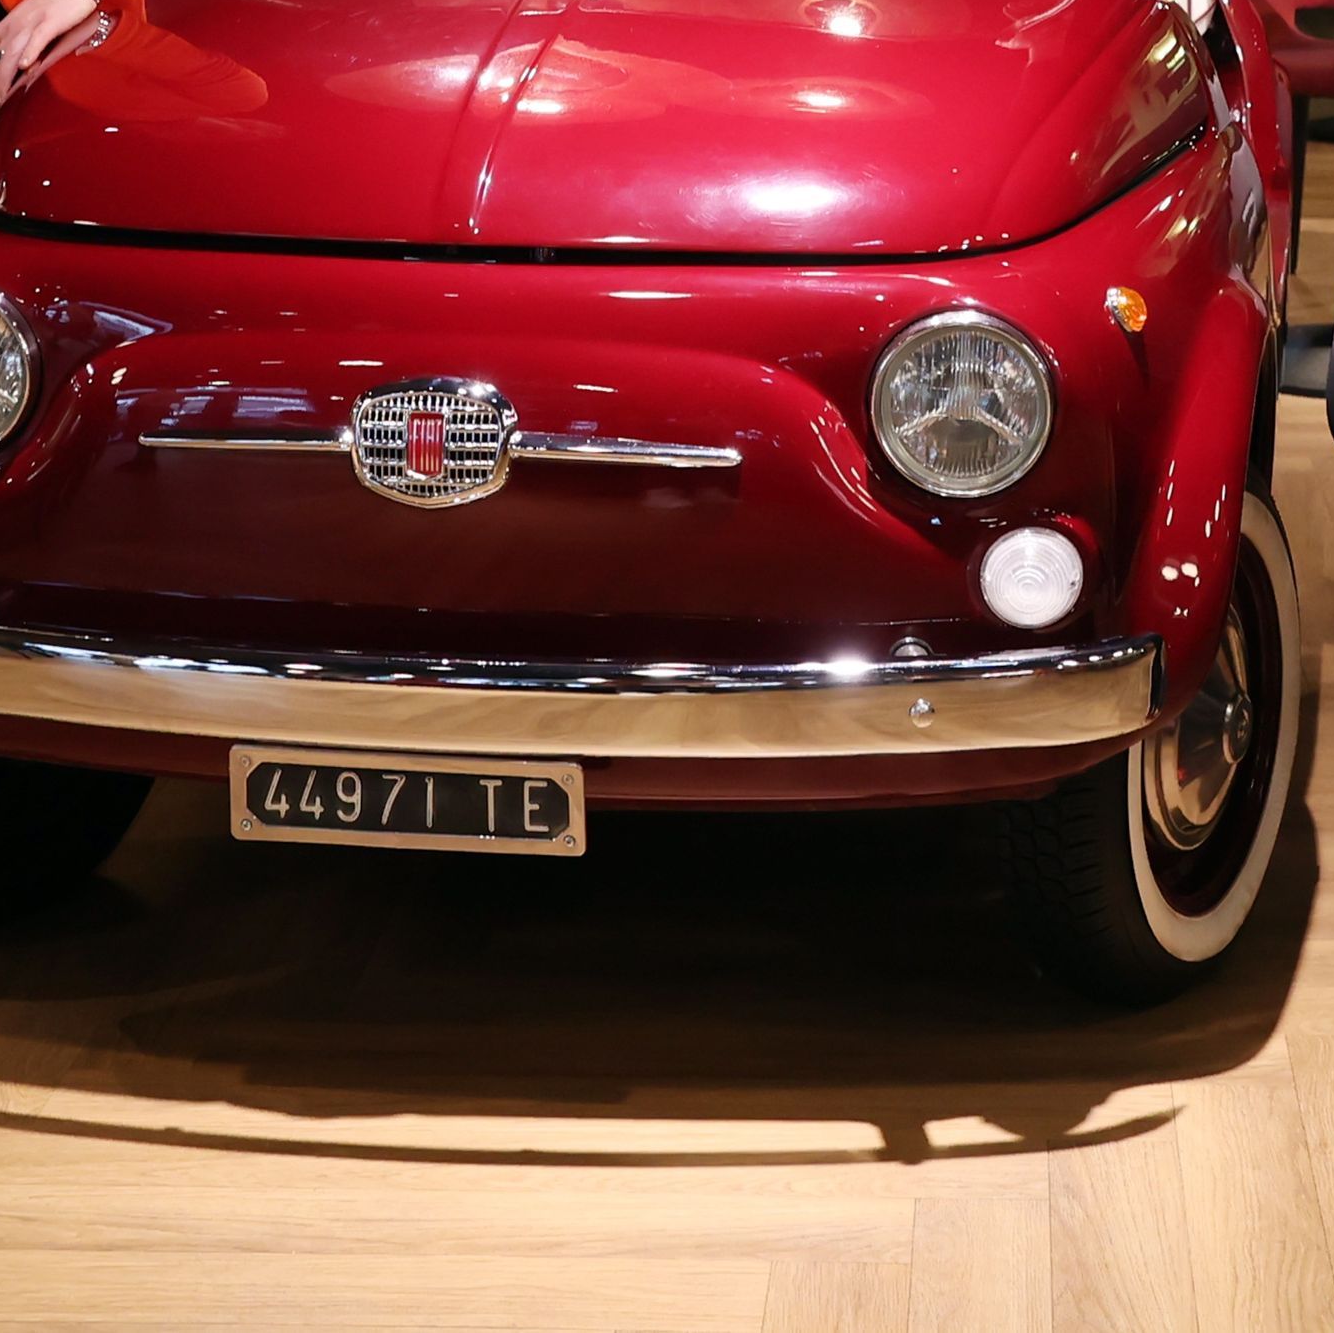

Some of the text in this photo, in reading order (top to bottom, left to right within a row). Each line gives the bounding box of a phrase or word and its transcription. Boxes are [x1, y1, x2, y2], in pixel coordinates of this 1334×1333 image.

[412, 418, 443, 443] FIAT
[264, 768, 551, 834] 44971 TE
